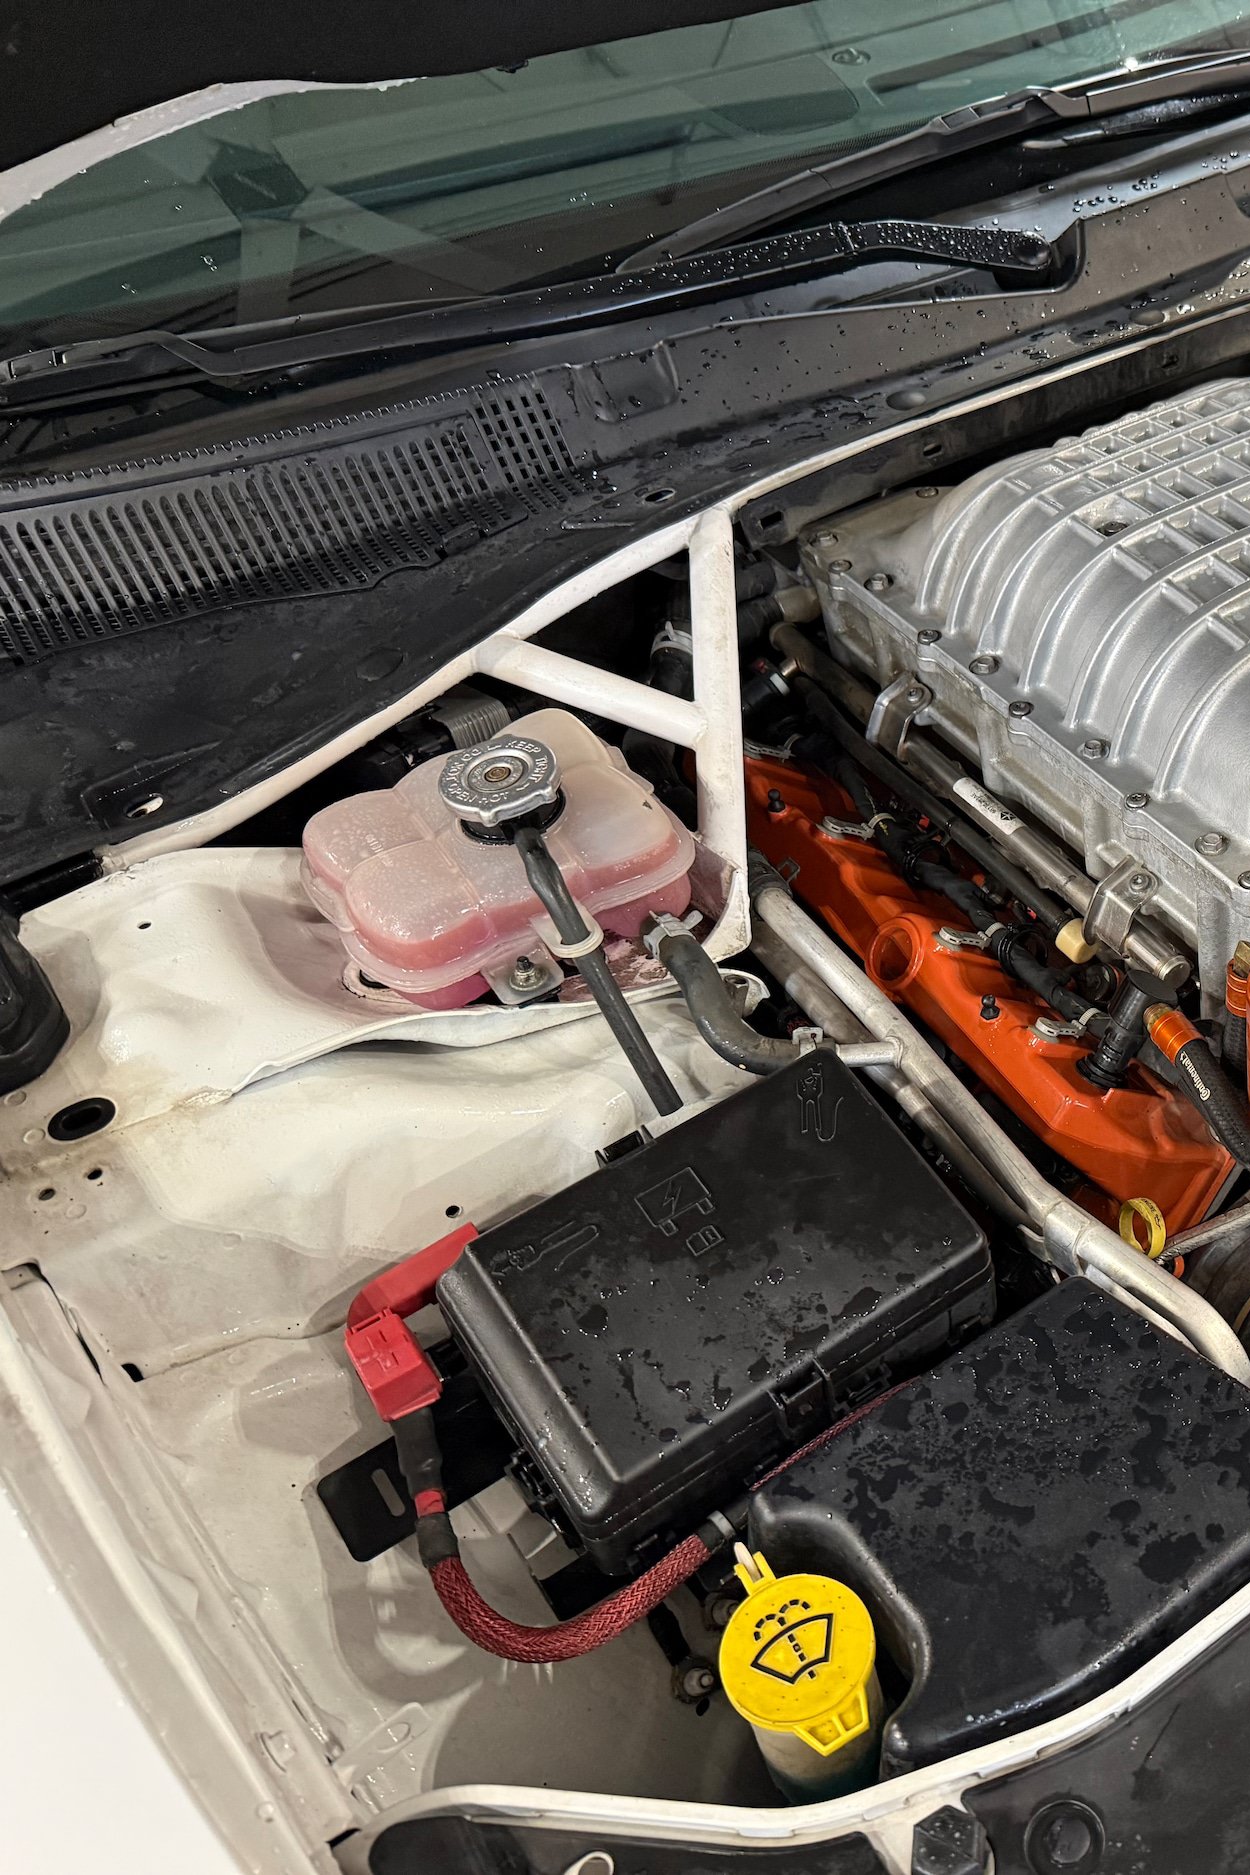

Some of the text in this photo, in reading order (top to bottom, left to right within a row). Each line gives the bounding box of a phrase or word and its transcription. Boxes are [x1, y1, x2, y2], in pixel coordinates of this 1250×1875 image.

[505, 740, 541, 753] KEEP
[446, 748, 509, 804] DO NOT OPEN HOT
[1180, 1056, 1211, 1101] Continental
